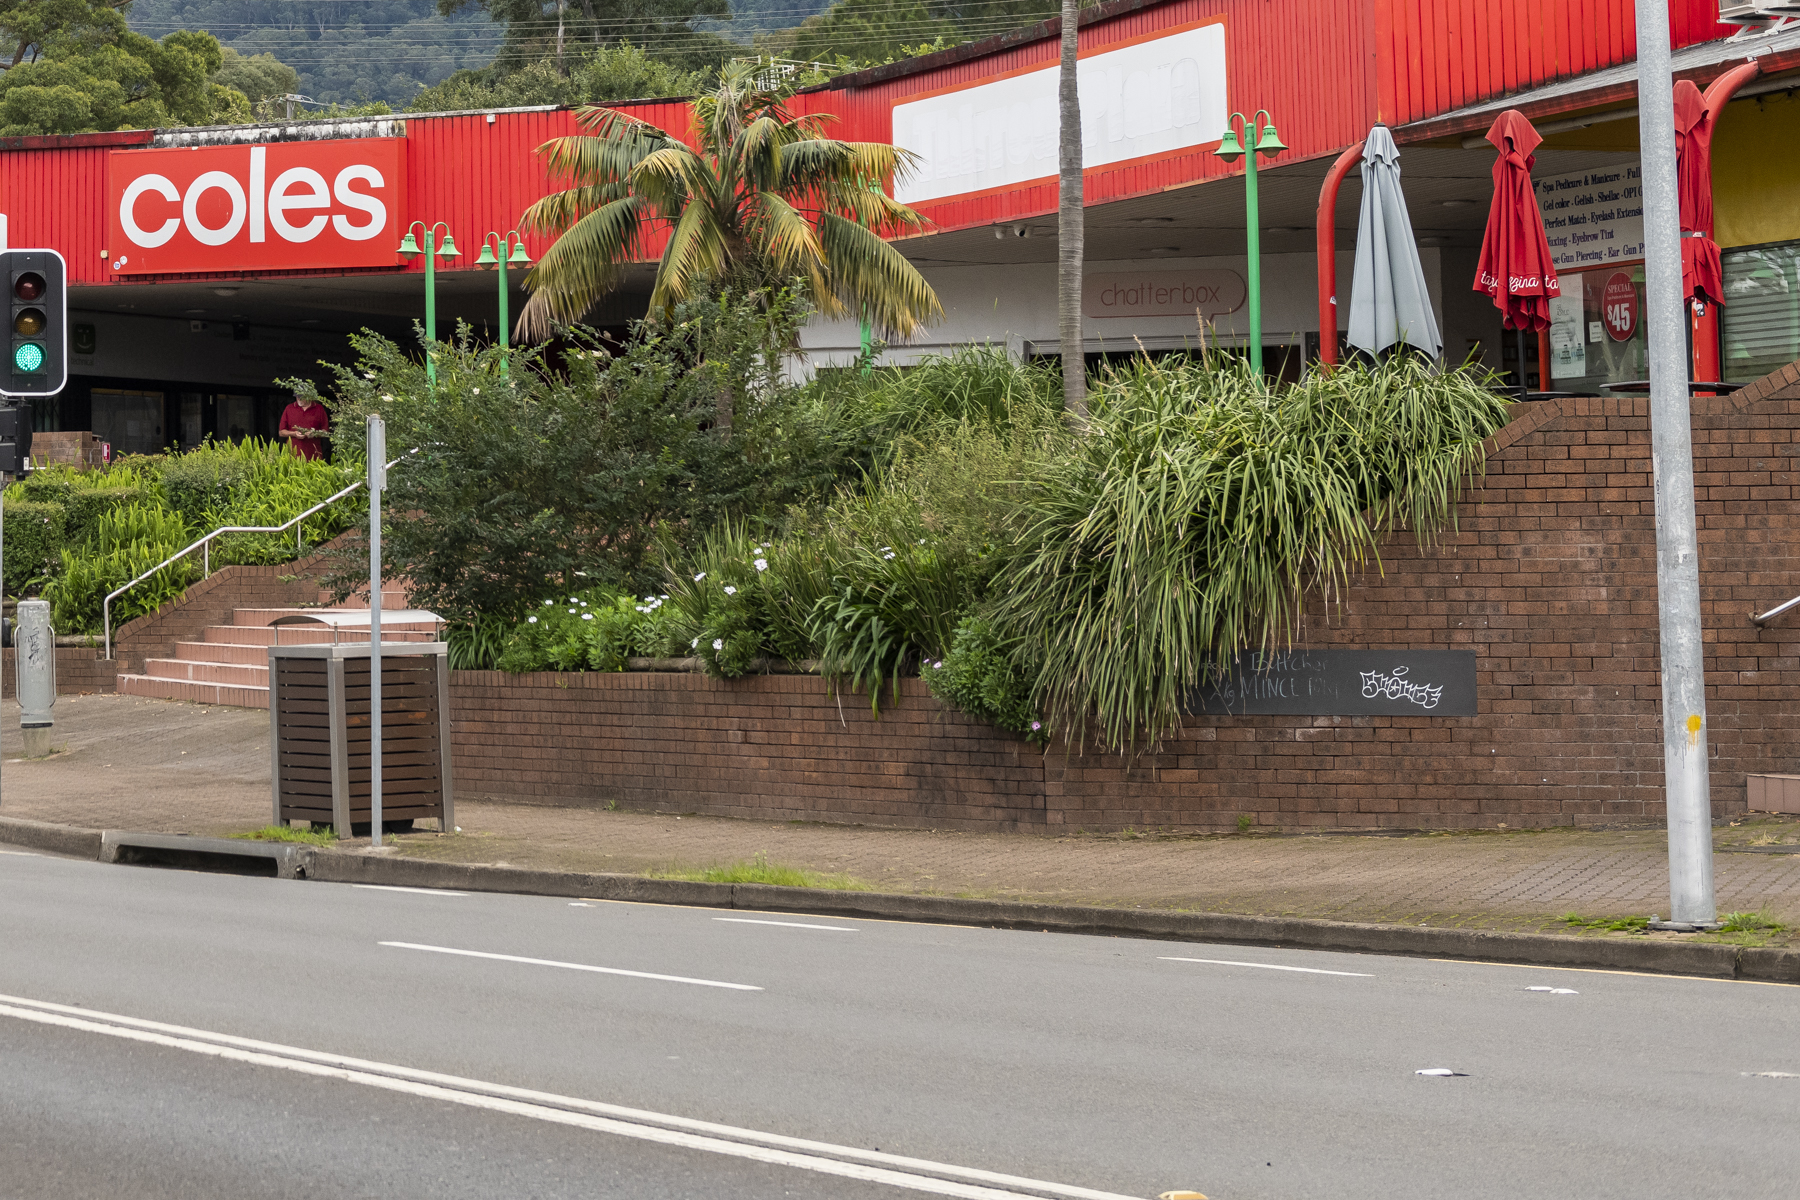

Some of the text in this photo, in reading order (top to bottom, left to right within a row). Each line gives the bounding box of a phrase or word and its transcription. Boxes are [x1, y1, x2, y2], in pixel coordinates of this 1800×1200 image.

[1542, 181, 1554, 194] Spa
[1555, 178, 1582, 191] Pedicure
[1583, 175, 1590, 186] &
[1591, 172, 1621, 186] Manicure
[119, 146, 388, 249] coles
[1543, 199, 1554, 211] Gel
[1555, 198, 1570, 210] color
[1574, 193, 1594, 206] Gelish
[1597, 190, 1620, 203] Shellac
[1623, 186, 1637, 199] OPI
[1544, 216, 1567, 229] Perfect
[1567, 213, 1587, 226] Match
[1590, 209, 1615, 225] Eyelash
[1571, 231, 1599, 246] Eyebrow
[1600, 228, 1614, 240] Tint
[1560, 252, 1575, 263] Gun
[1575, 249, 1604, 262] Piercing
[1607, 246, 1621, 258] Ear
[1622, 243, 1637, 256] Gun
[1100, 281, 1221, 307] chatterbox
[1607, 282, 1632, 294] SPECIAL
[1607, 302, 1631, 332] $45
